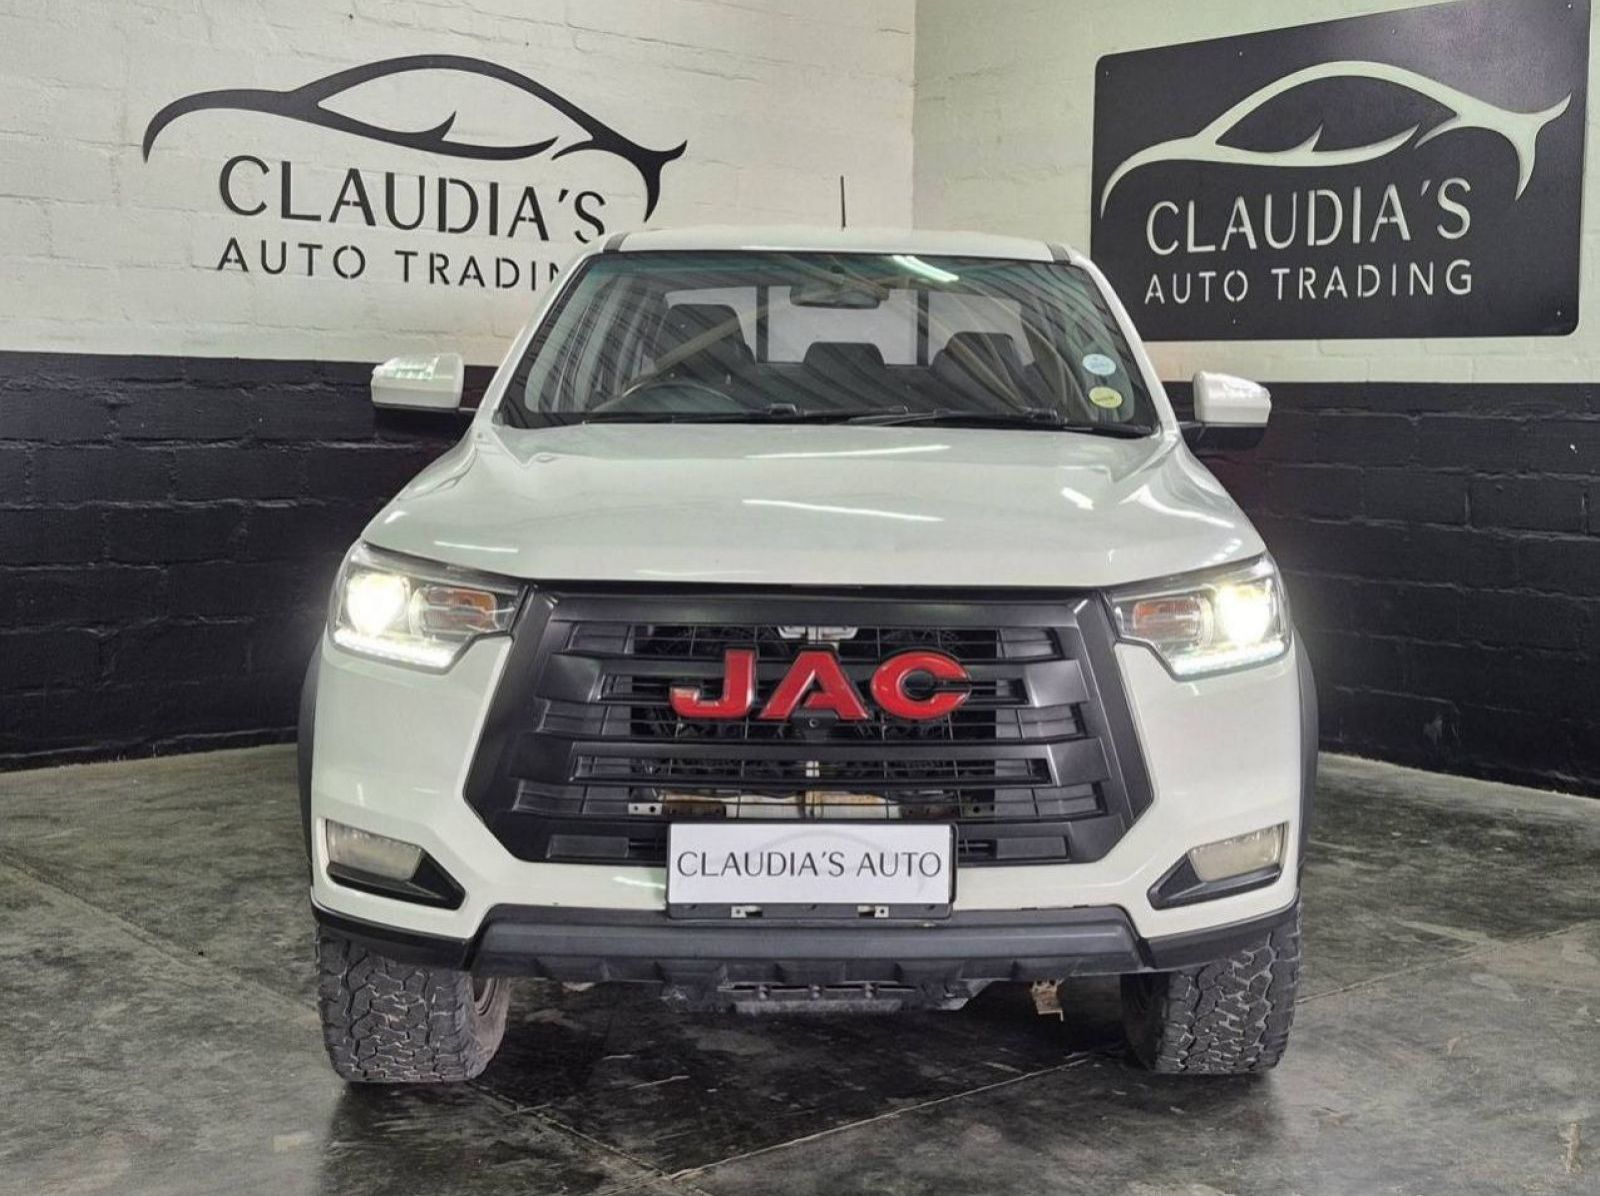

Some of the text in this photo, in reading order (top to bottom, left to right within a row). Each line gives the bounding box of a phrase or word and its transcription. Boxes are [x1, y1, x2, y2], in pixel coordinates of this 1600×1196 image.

[219, 155, 606, 243] CLAUDIA'S
[1146, 177, 1472, 256] CLAUDIA'S
[217, 237, 559, 291] AUTO TRADI
[1145, 259, 1473, 304] AUTO TRADING
[669, 648, 972, 721] JAC
[676, 850, 942, 878] CLAUDIA'S AUTO
